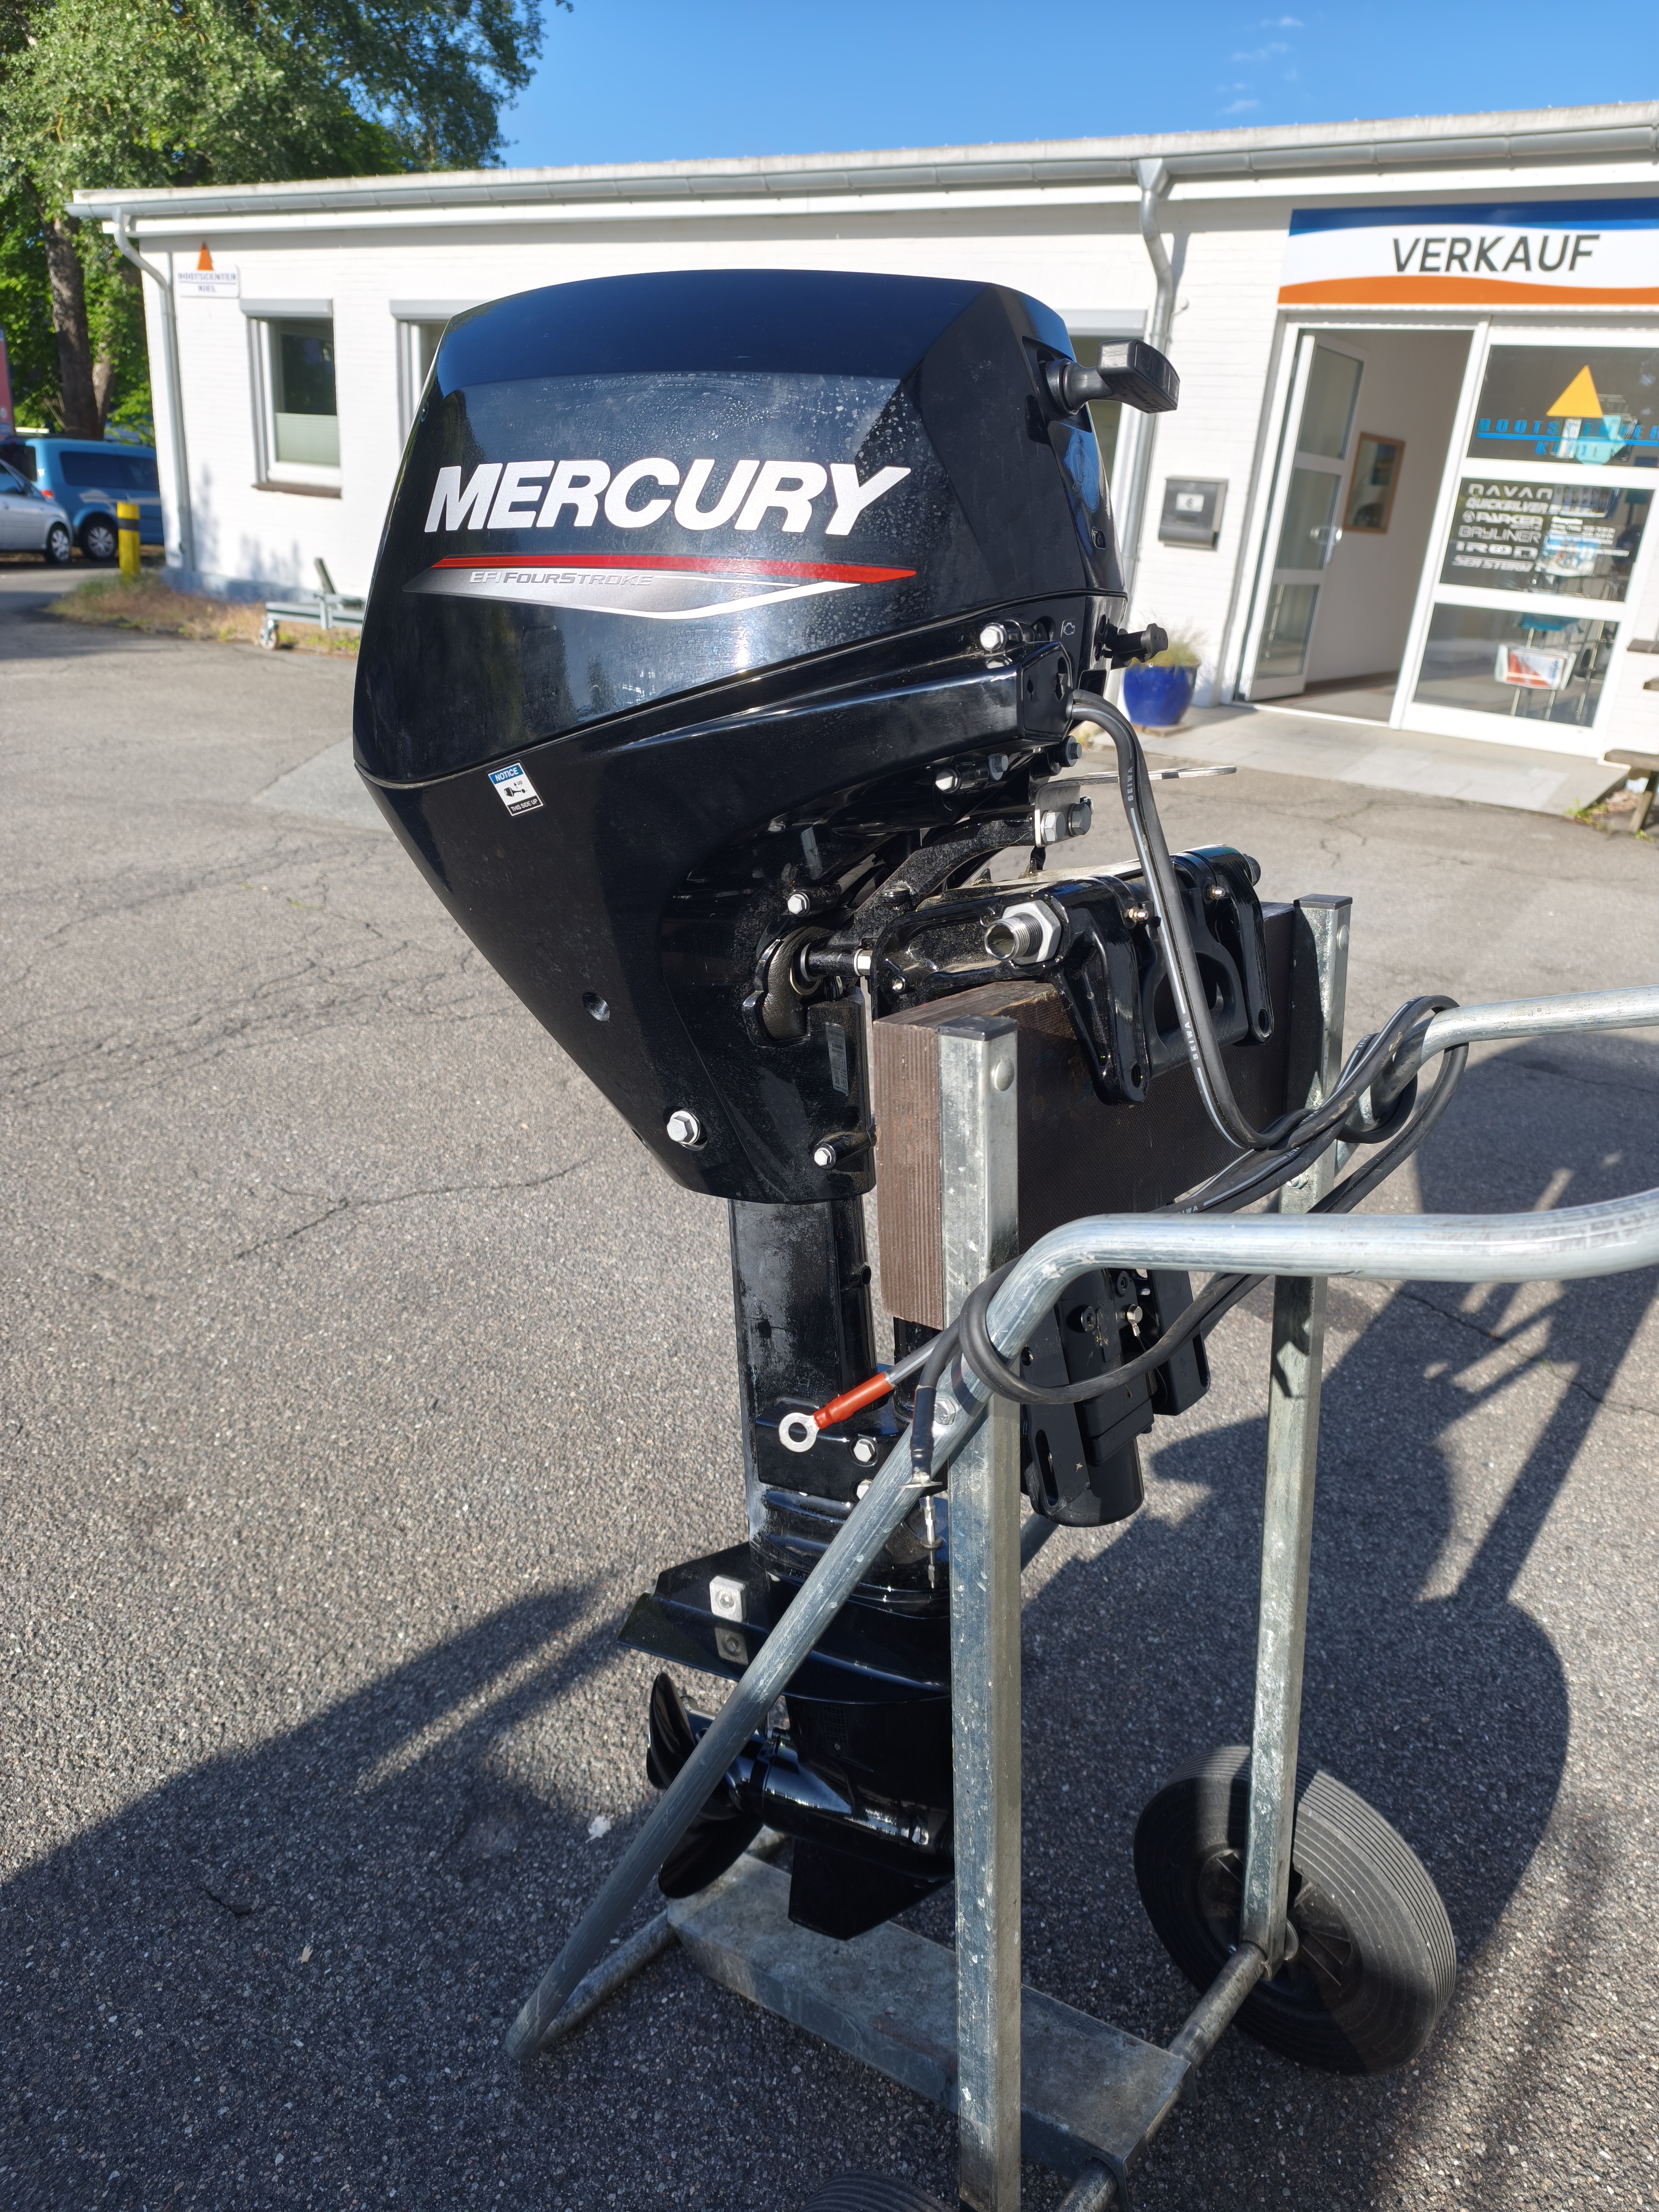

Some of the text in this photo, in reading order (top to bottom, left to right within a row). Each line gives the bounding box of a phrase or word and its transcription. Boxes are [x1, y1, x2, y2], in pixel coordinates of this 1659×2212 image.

[1393, 234, 1600, 272] VERKAUF
[424, 458, 912, 536] MERCURY
[1459, 525, 1542, 543] BAYLINER
[495, 767, 519, 782] NOTICE
[1184, 1021, 1199, 1060] SEIWA
